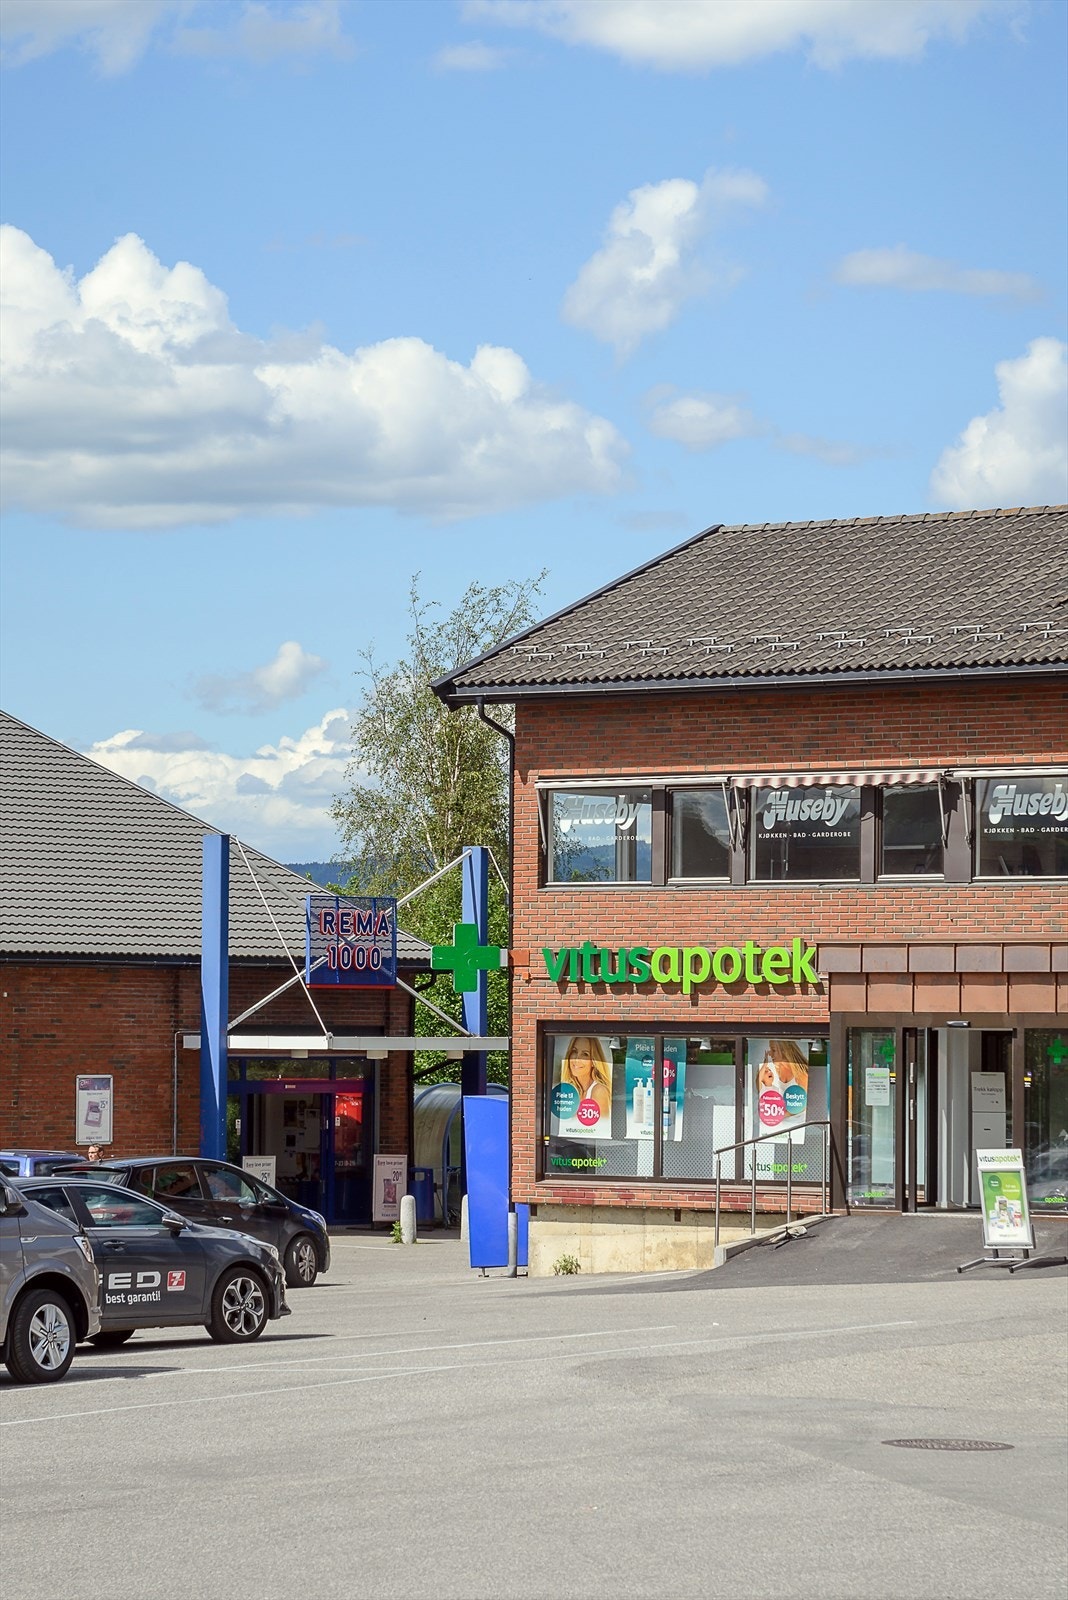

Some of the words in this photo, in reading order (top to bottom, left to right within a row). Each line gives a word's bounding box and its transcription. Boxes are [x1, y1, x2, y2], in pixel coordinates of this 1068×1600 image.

[560, 795, 642, 833] Huseby
[763, 790, 851, 829] Huseby
[319, 909, 390, 936] REMA
[326, 944, 382, 971] 1000
[543, 938, 818, 994] vitusapotek
[635, 1043, 650, 1052] Pleie
[786, 1092, 805, 1101] Beskytt
[578, 1108, 599, 1119] -30%
[760, 1103, 785, 1116] -50%
[105, 1292, 126, 1304] best
[127, 1290, 161, 1305] garanti!
